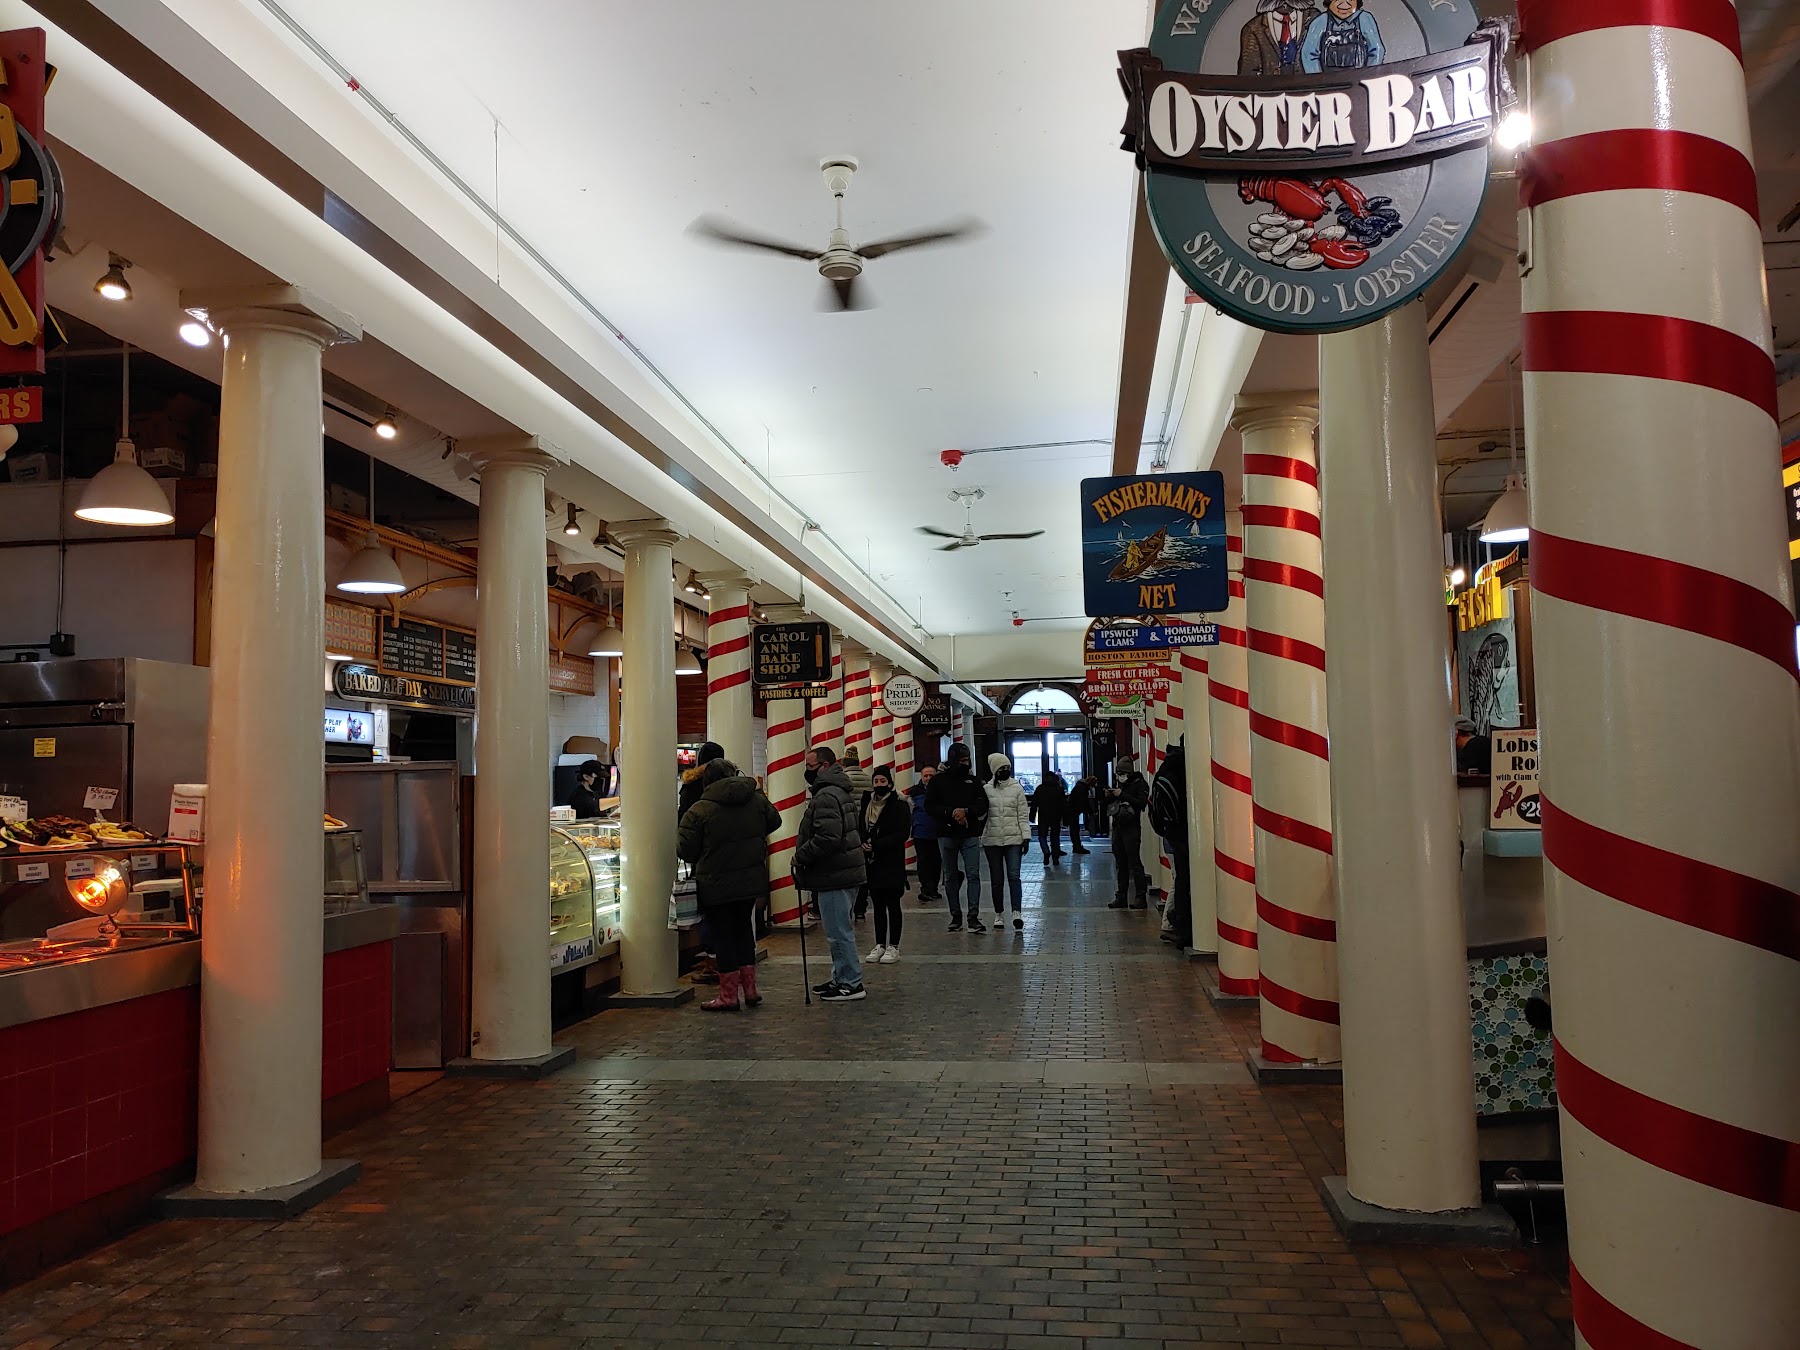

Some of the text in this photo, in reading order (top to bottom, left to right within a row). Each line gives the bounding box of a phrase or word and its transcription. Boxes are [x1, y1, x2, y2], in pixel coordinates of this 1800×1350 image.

[1148, 65, 1493, 157] OYSTER BAR
[1183, 212, 1463, 315] SEAFOOD LOBSTER
[1092, 481, 1211, 523] FISHERMAN'S
[1138, 583, 1176, 609] NET
[760, 632, 810, 643] CAROL
[1101, 625, 1217, 641] IPSWICH & HOMEMADE
[1105, 634, 1215, 647] CLAMS CHOWDER
[760, 643, 789, 654] ANN
[760, 652, 801, 665] BAKE
[1088, 650, 1167, 661] BOSTON FAMOUS
[760, 664, 801, 675] SHOP
[1097, 668, 1160, 680] FRESH CUT FRIES
[344, 671, 381, 693] BAKED
[383, 678, 403, 696] ALL
[405, 679, 422, 698] DAY
[1088, 681, 1169, 693] BROILED SCALLOPS
[760, 687, 826, 699] PASTRIES & COFFEE
[885, 687, 921, 699] PRIME
[920, 714, 948, 722] Parris
[1514, 773, 1531, 781] Clam
